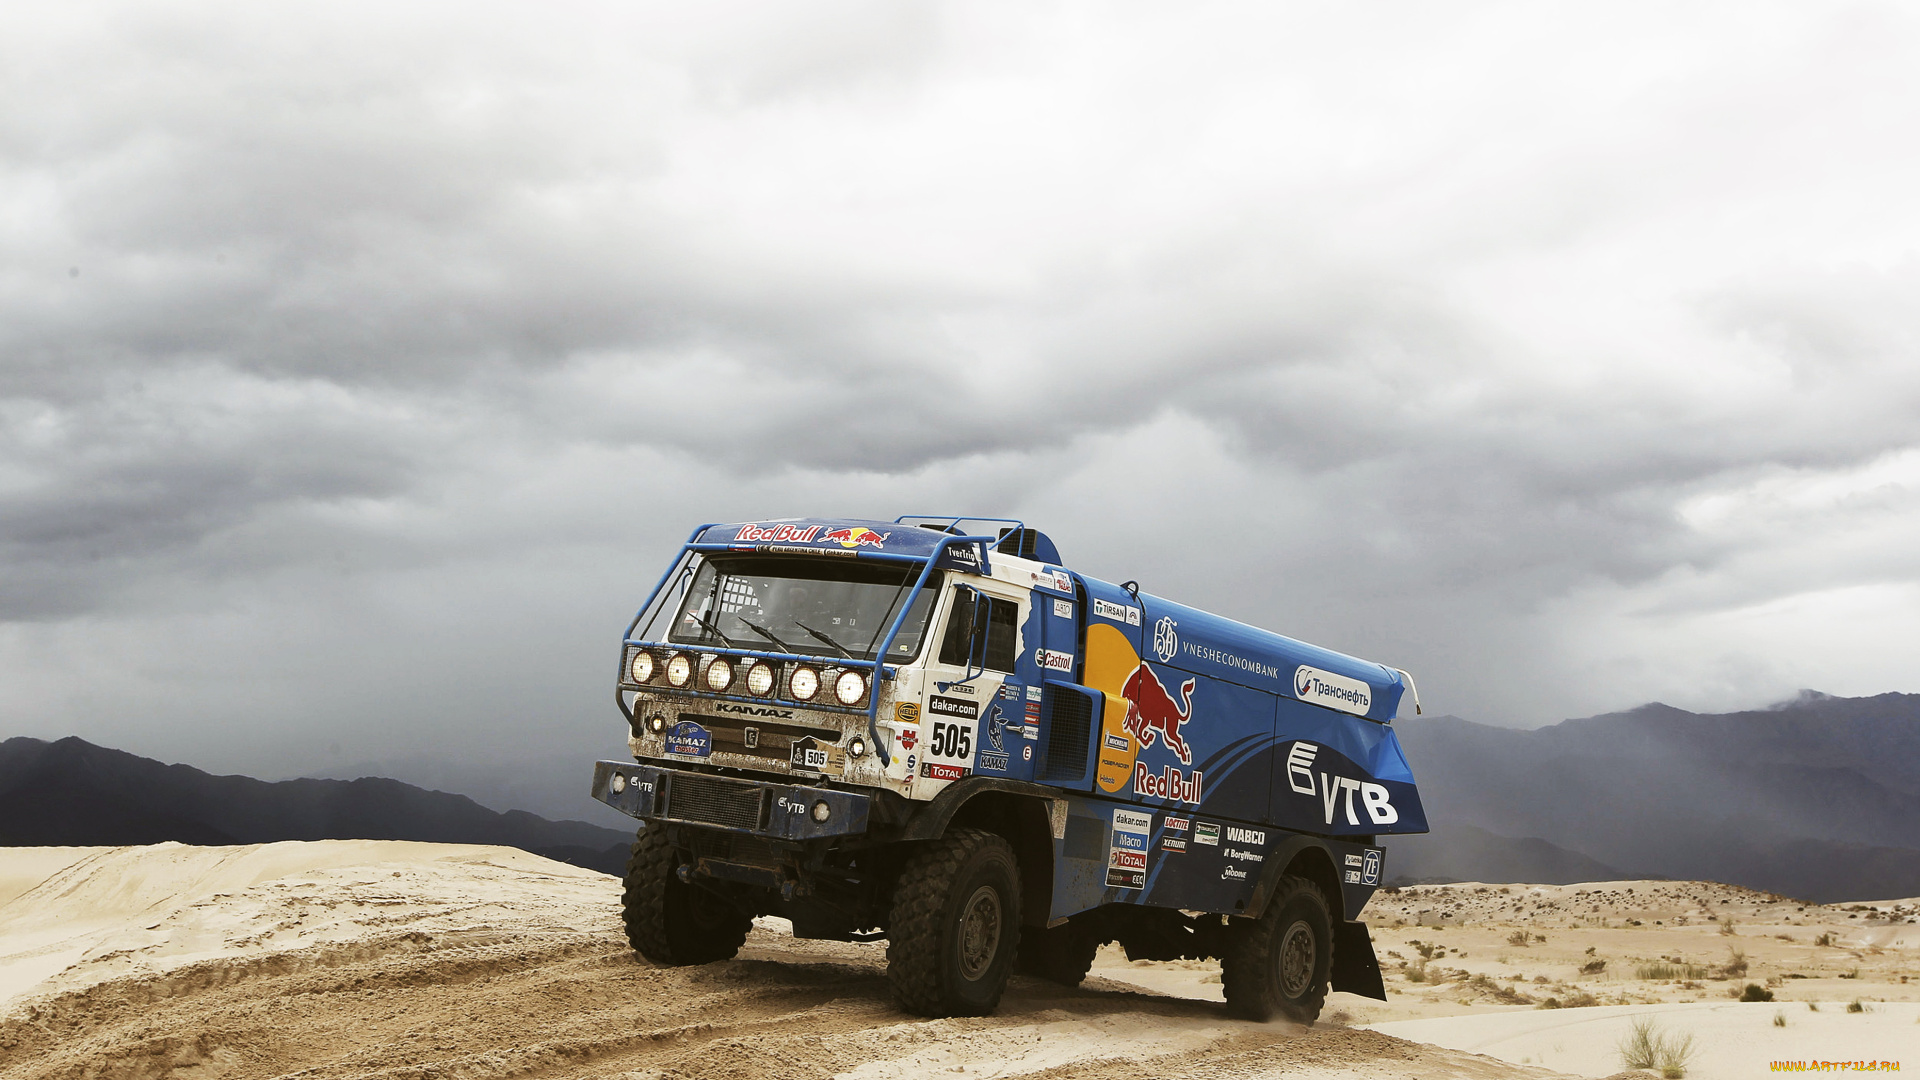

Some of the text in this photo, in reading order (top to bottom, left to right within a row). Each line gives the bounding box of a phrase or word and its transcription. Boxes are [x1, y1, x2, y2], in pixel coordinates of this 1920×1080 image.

[734, 524, 824, 543] Red Bull
[1045, 652, 1072, 670] Castrol
[1182, 641, 1279, 679] VNESHECONOMBANK
[1312, 678, 1369, 706] Транснефть
[716, 703, 793, 719] KAMAZ
[932, 698, 976, 715] dakar.com
[668, 736, 706, 747] KAMAZ
[931, 722, 971, 759] 505
[807, 752, 826, 765] 505
[980, 755, 1008, 771] KAMAZ
[933, 766, 960, 778] TOTAL
[638, 782, 653, 792] VTB
[1134, 760, 1203, 805] Red Bull
[1320, 771, 1399, 826] VTB
[787, 802, 805, 814] VTB
[1116, 814, 1148, 828] dakar.com
[1165, 818, 1189, 830] LOCTITE
[1119, 834, 1142, 848] Macro
[1227, 826, 1265, 845] WABCO
[1119, 854, 1144, 868] TOTAL
[1231, 849, 1263, 862] BorgWarner
[1225, 869, 1247, 879] MODINE
